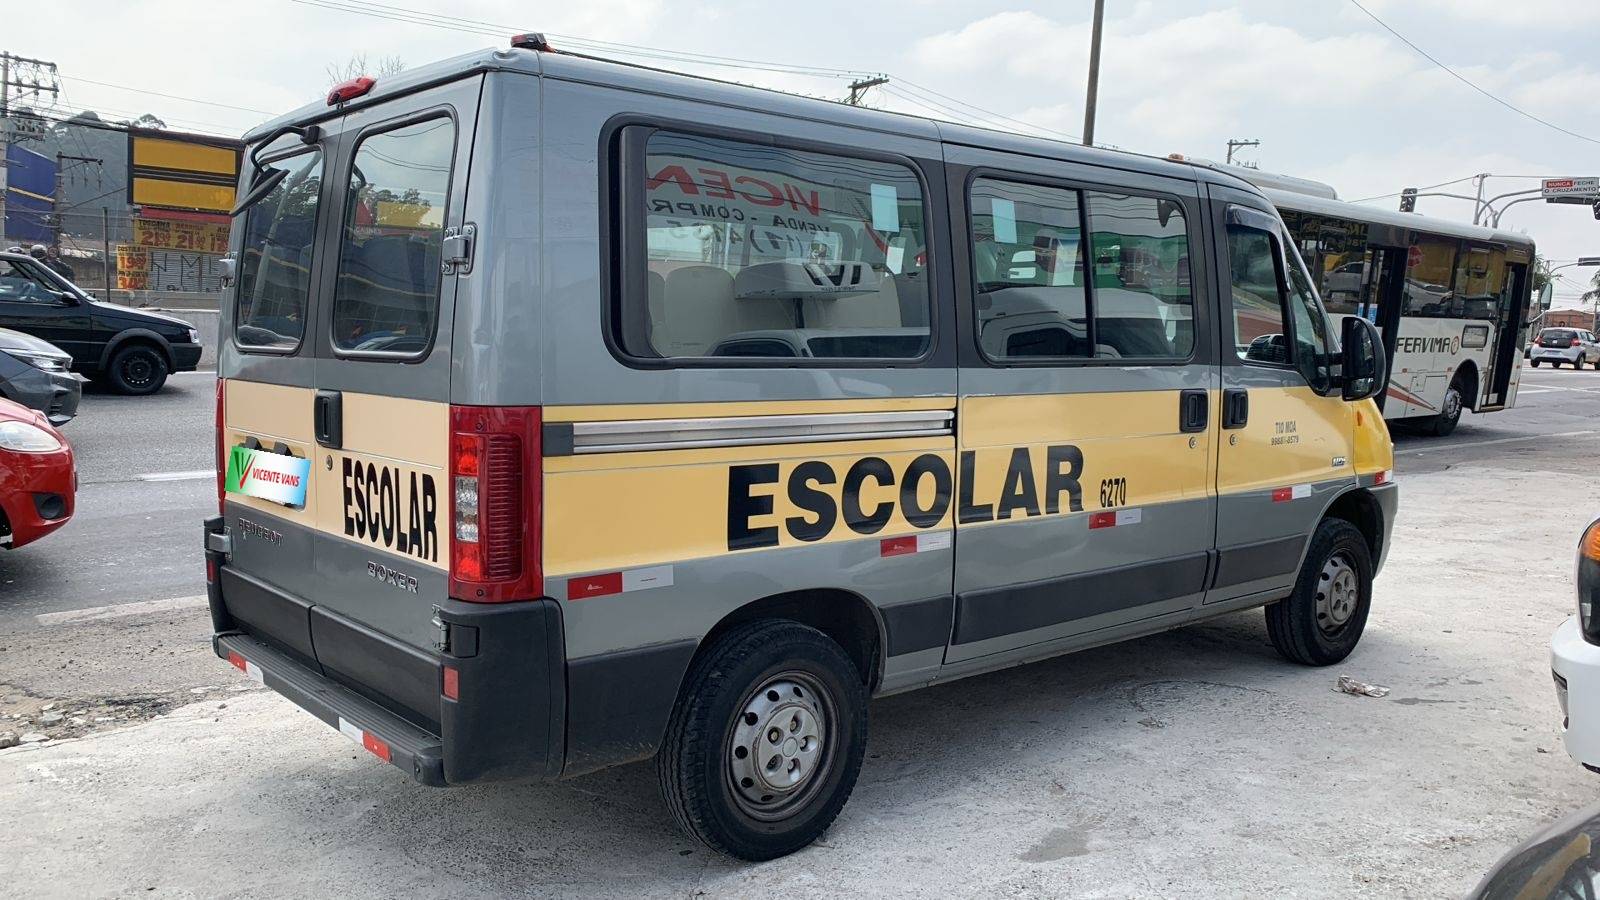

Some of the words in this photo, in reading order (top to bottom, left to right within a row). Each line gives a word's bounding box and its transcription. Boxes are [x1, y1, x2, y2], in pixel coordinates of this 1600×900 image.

[1395, 337, 1451, 353] FERVIMA
[728, 445, 1084, 551] ESCOLAR
[1100, 477, 1127, 508] 6270
[342, 457, 438, 562] ESCOLAR
[238, 517, 283, 547] PEUGEOT
[367, 560, 418, 595] BOXER
